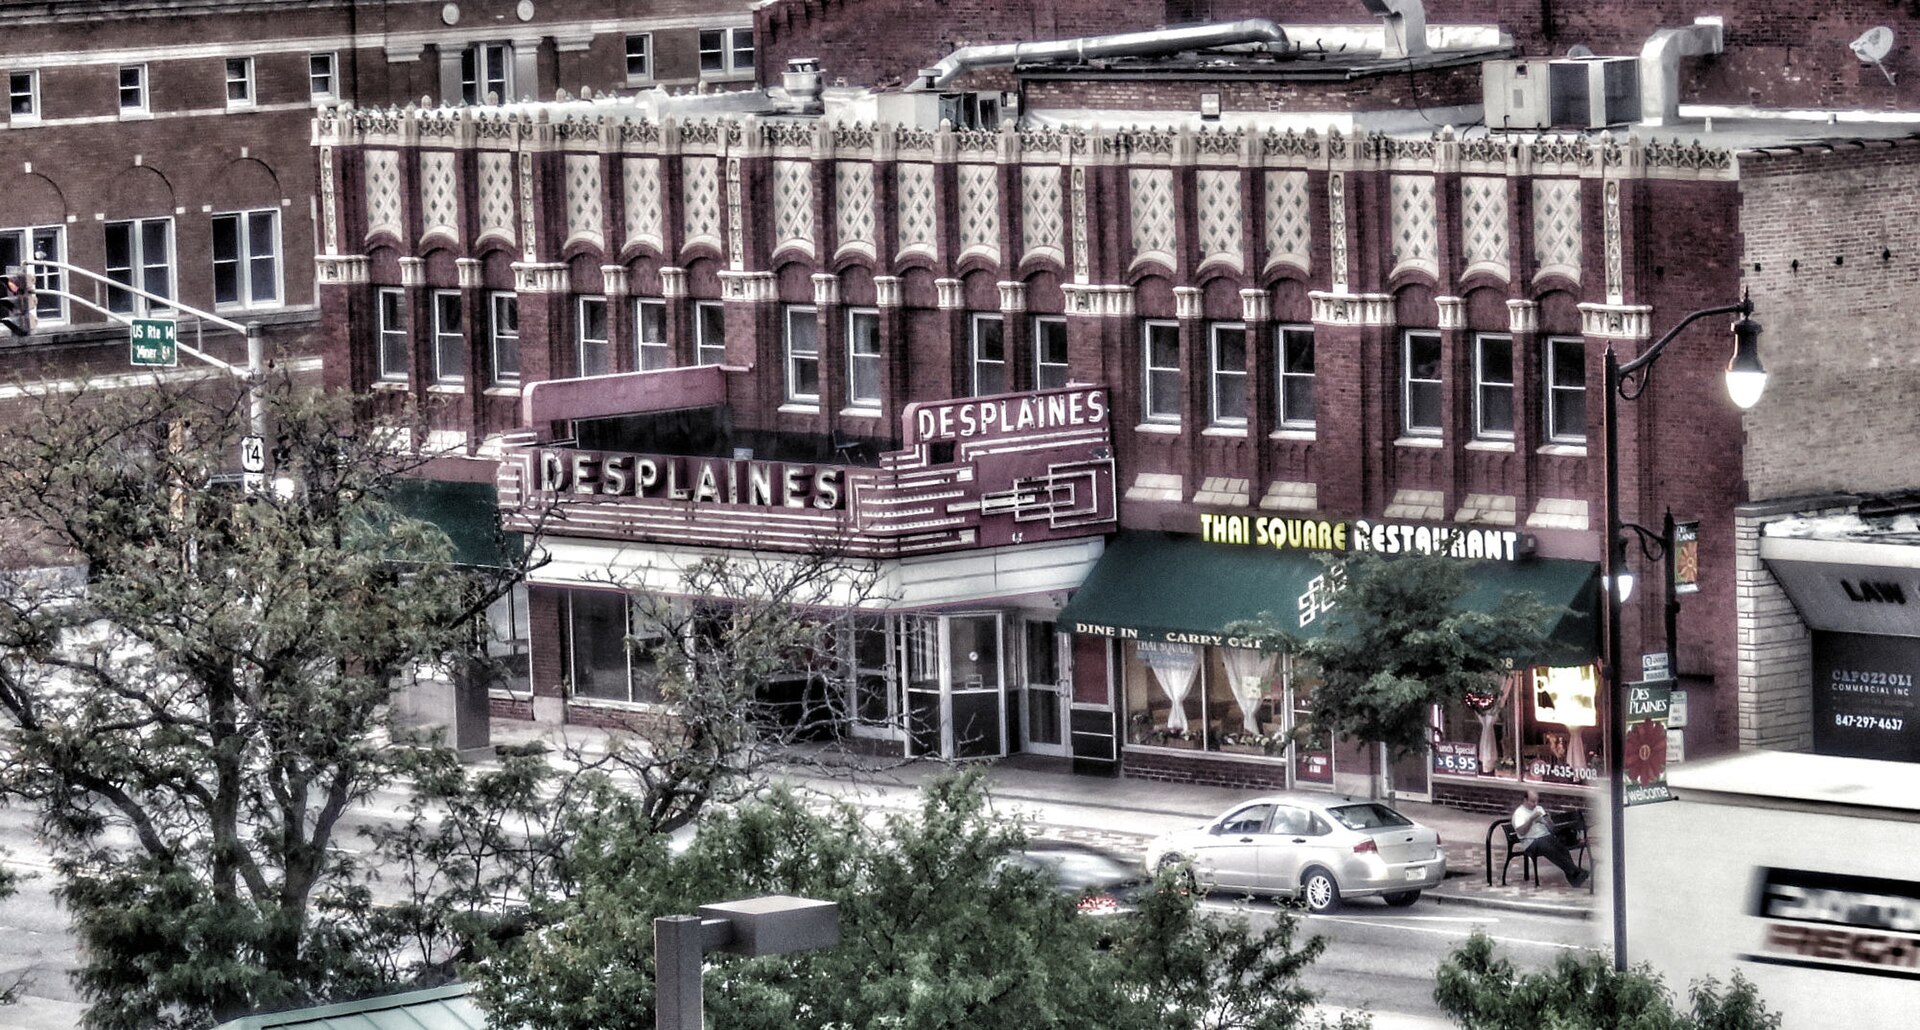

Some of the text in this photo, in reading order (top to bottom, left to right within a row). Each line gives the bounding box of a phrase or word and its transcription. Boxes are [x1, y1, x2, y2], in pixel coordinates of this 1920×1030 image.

[132, 324, 143, 339] US
[165, 325, 174, 340] 14
[918, 391, 1104, 441] DESPLAINES
[246, 445, 260, 464] 14
[540, 451, 839, 510] DESPLAINES
[1200, 513, 1517, 561] THAI SQUARE RESTAURANT
[1840, 578, 1907, 605] LAW
[1076, 622, 1116, 637] DINE
[1120, 627, 1138, 639] IN
[1166, 632, 1223, 647] CARRY
[1832, 669, 1912, 687] CAPOZZOLI
[1630, 687, 1650, 701] DES
[1832, 682, 1909, 697] COMMERCIAL INC
[1629, 699, 1668, 714] PLAINES
[1835, 713, 1903, 731] 847-297-4637
[1533, 762, 1598, 780] 847-635-1008
[1628, 785, 1669, 803] welcome
